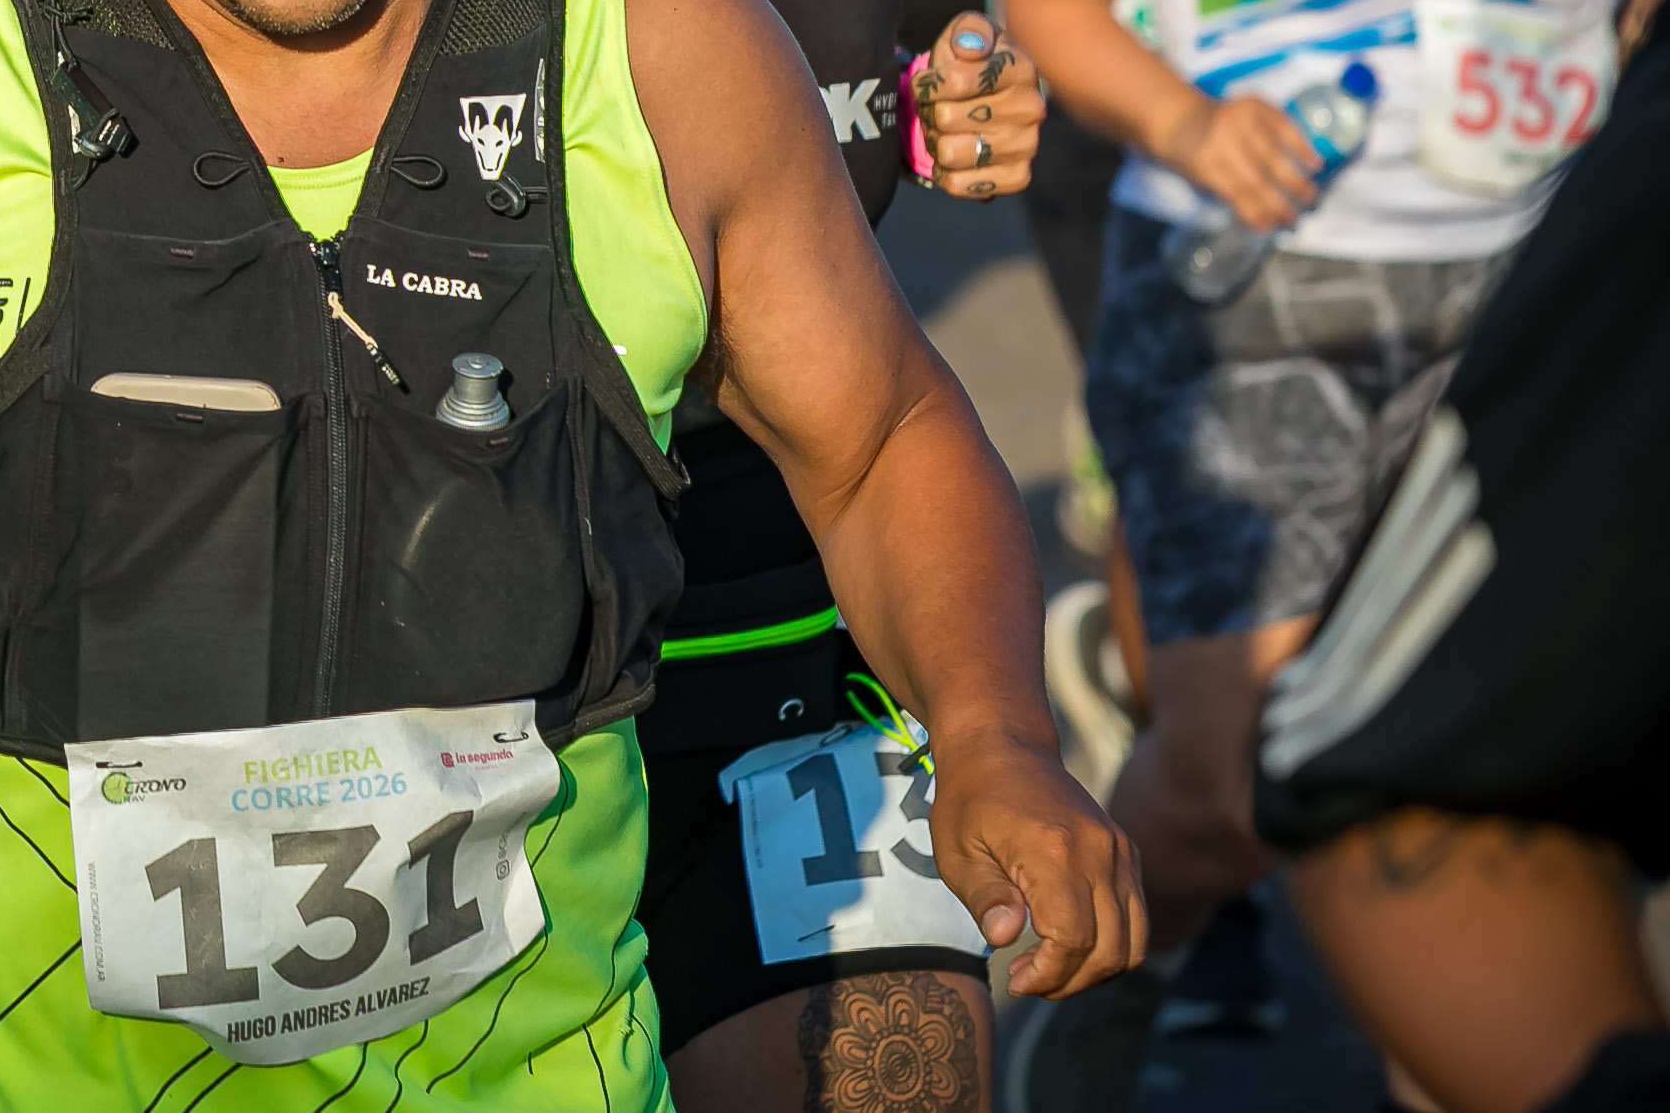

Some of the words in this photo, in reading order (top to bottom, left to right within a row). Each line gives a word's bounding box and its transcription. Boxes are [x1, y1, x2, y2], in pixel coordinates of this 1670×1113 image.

[1451, 48, 1601, 149] 532
[366, 264, 396, 288] LA
[402, 272, 483, 301] CABRA
[243, 746, 383, 784] FIGHIERA
[455, 751, 467, 764] la
[467, 747, 514, 765] segunda
[231, 781, 331, 813] CORRE
[339, 771, 408, 803] 2026
[144, 810, 484, 1011] 131
[227, 1015, 277, 1044] HUGO
[280, 998, 351, 1035] ANDRES
[354, 975, 430, 1018] ALVAREZ
